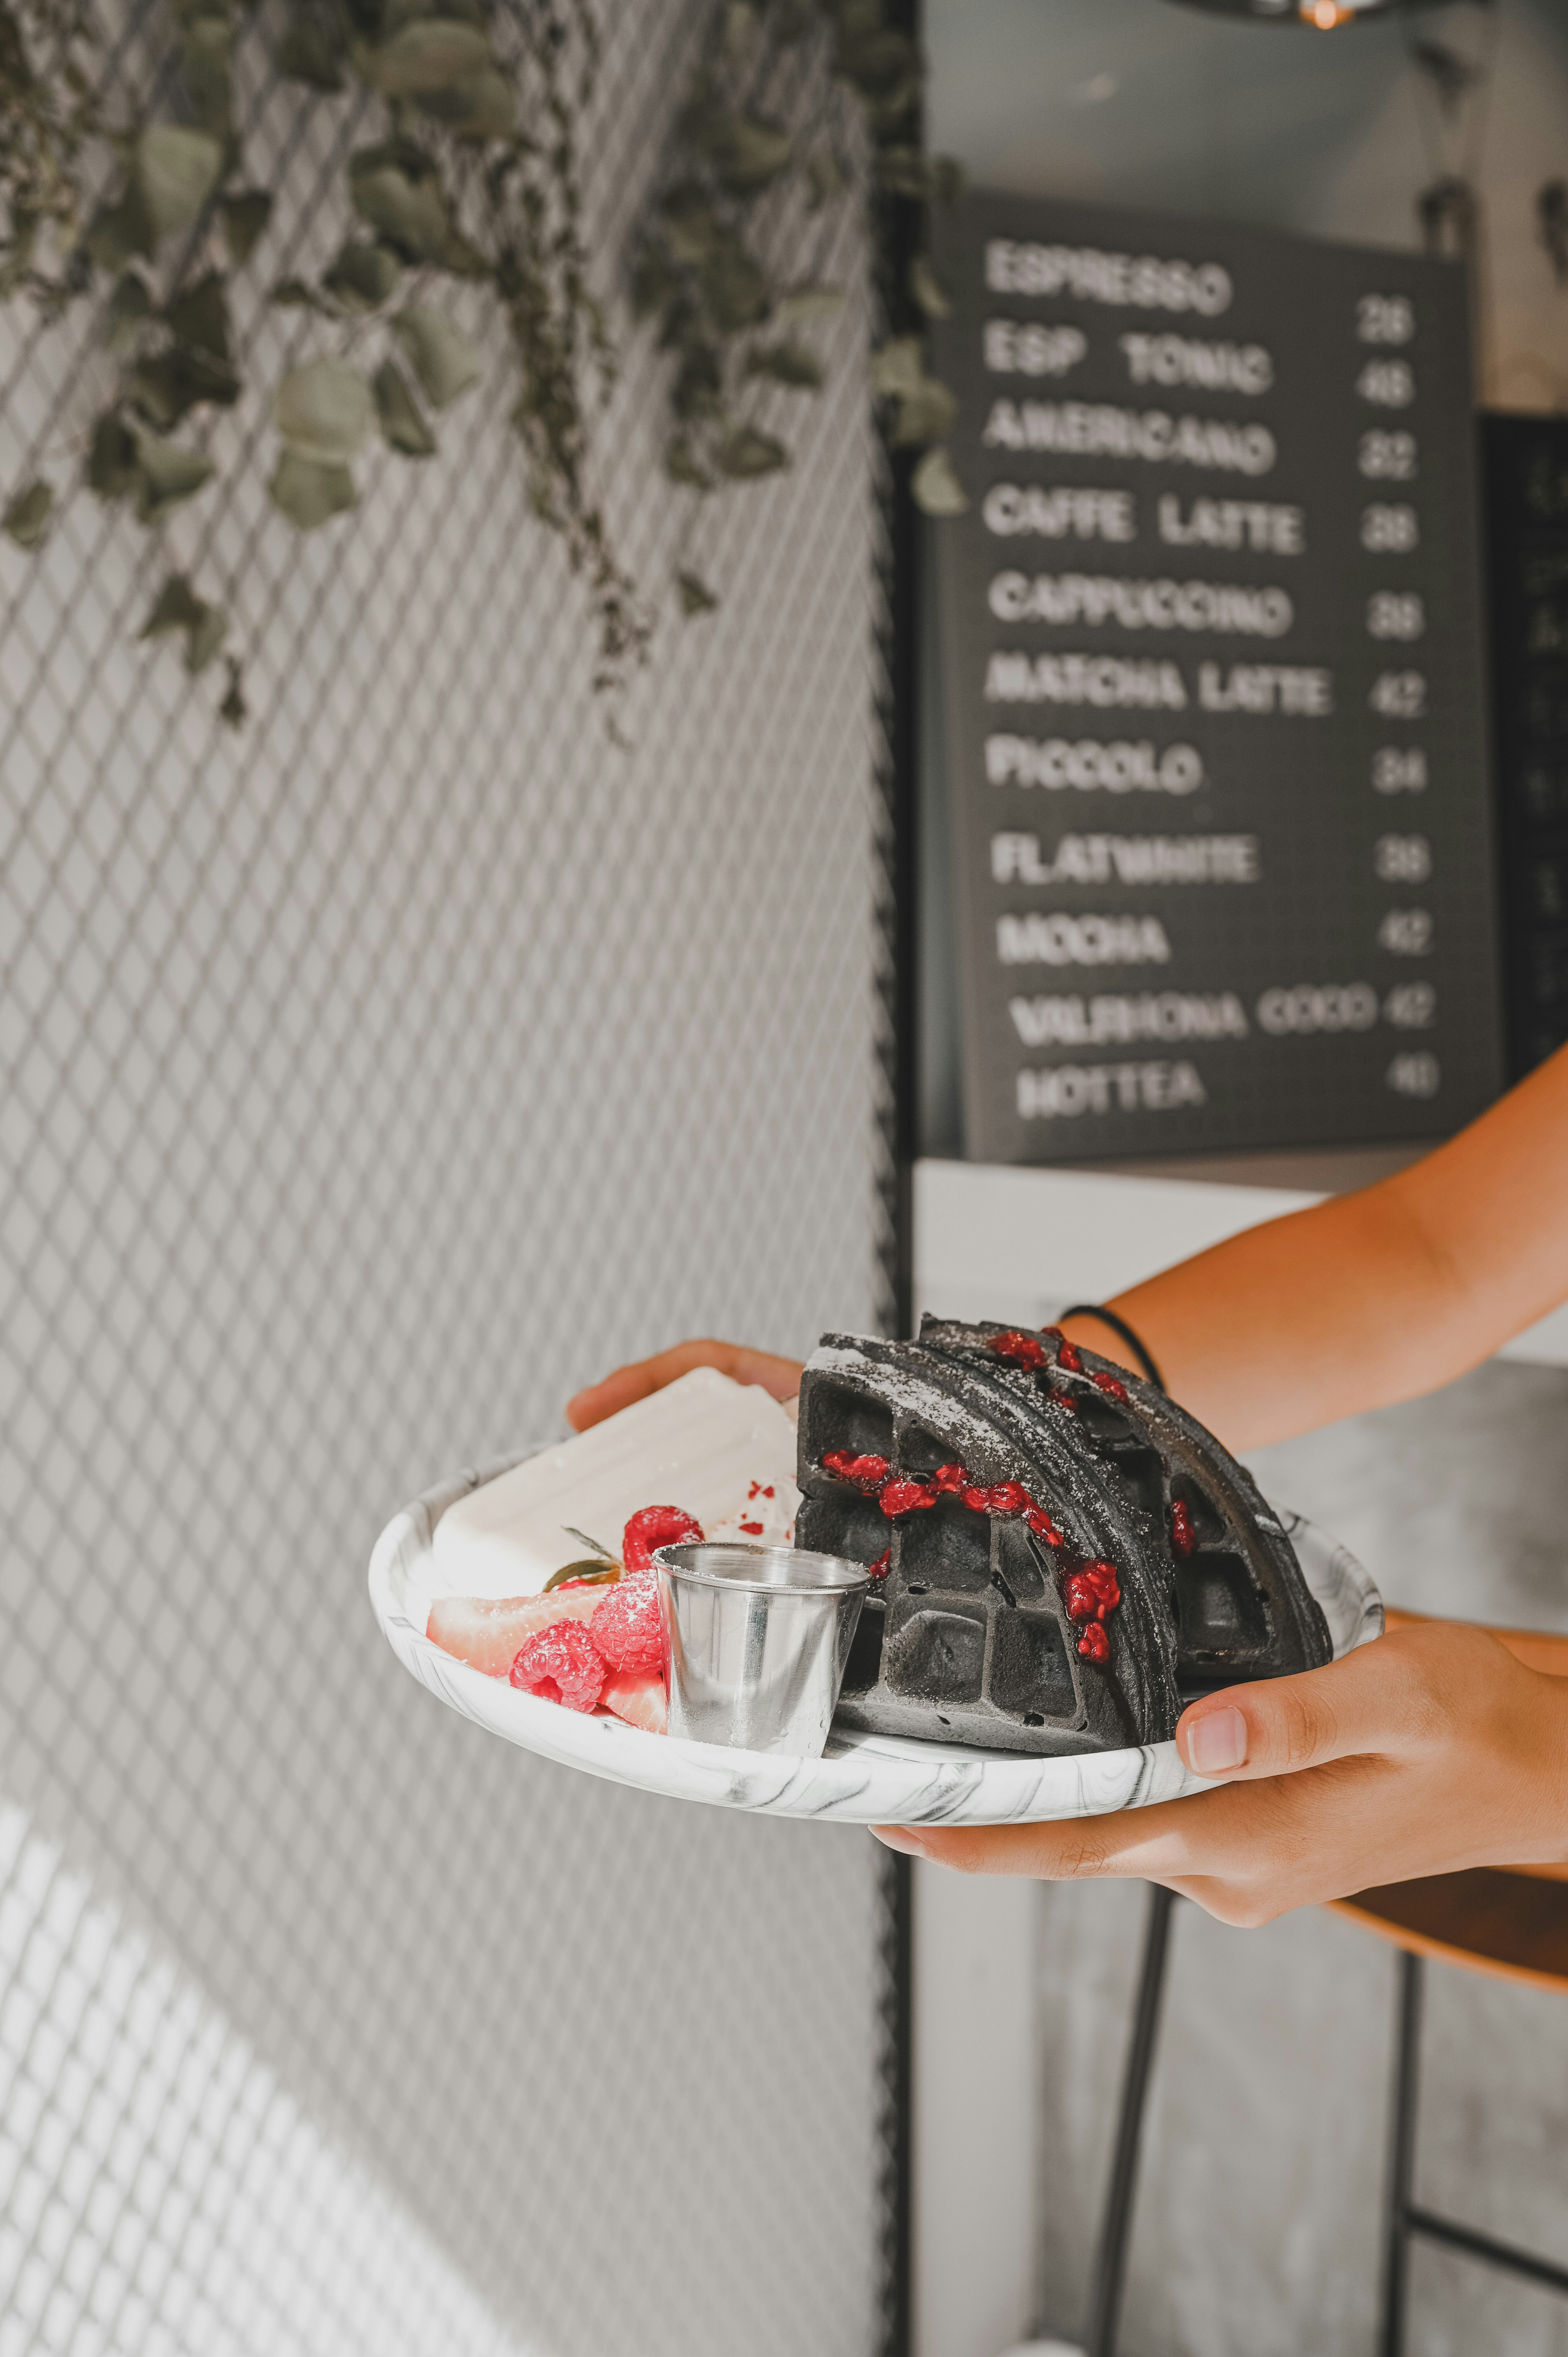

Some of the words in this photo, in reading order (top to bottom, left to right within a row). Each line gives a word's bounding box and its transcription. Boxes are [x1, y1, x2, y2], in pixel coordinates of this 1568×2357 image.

[987, 243, 1231, 315] ESPRESSO
[985, 321, 1085, 376] ESP
[1121, 334, 1270, 394] TONIC
[985, 401, 1275, 473] AMERICANO
[1359, 431, 1415, 479] 32
[983, 485, 1132, 541] CAFFE
[1159, 496, 1300, 554] LATTE
[1362, 506, 1416, 551] 38
[988, 572, 1291, 636] CAPPUCCINO
[1368, 593, 1422, 638] 38
[985, 654, 1185, 708] MATCHA
[1199, 664, 1328, 714] LATTE
[1371, 673, 1425, 717] 42
[985, 735, 1201, 794] PICCOLO
[1374, 749, 1426, 793] 34
[991, 834, 1254, 884] FLATWHITE
[1378, 837, 1429, 880] 38
[996, 915, 1169, 965] MOCHA
[1379, 911, 1430, 954] 42
[1257, 984, 1377, 1033] COCO
[1384, 984, 1434, 1027] 42
[1388, 1055, 1437, 1094] 40
